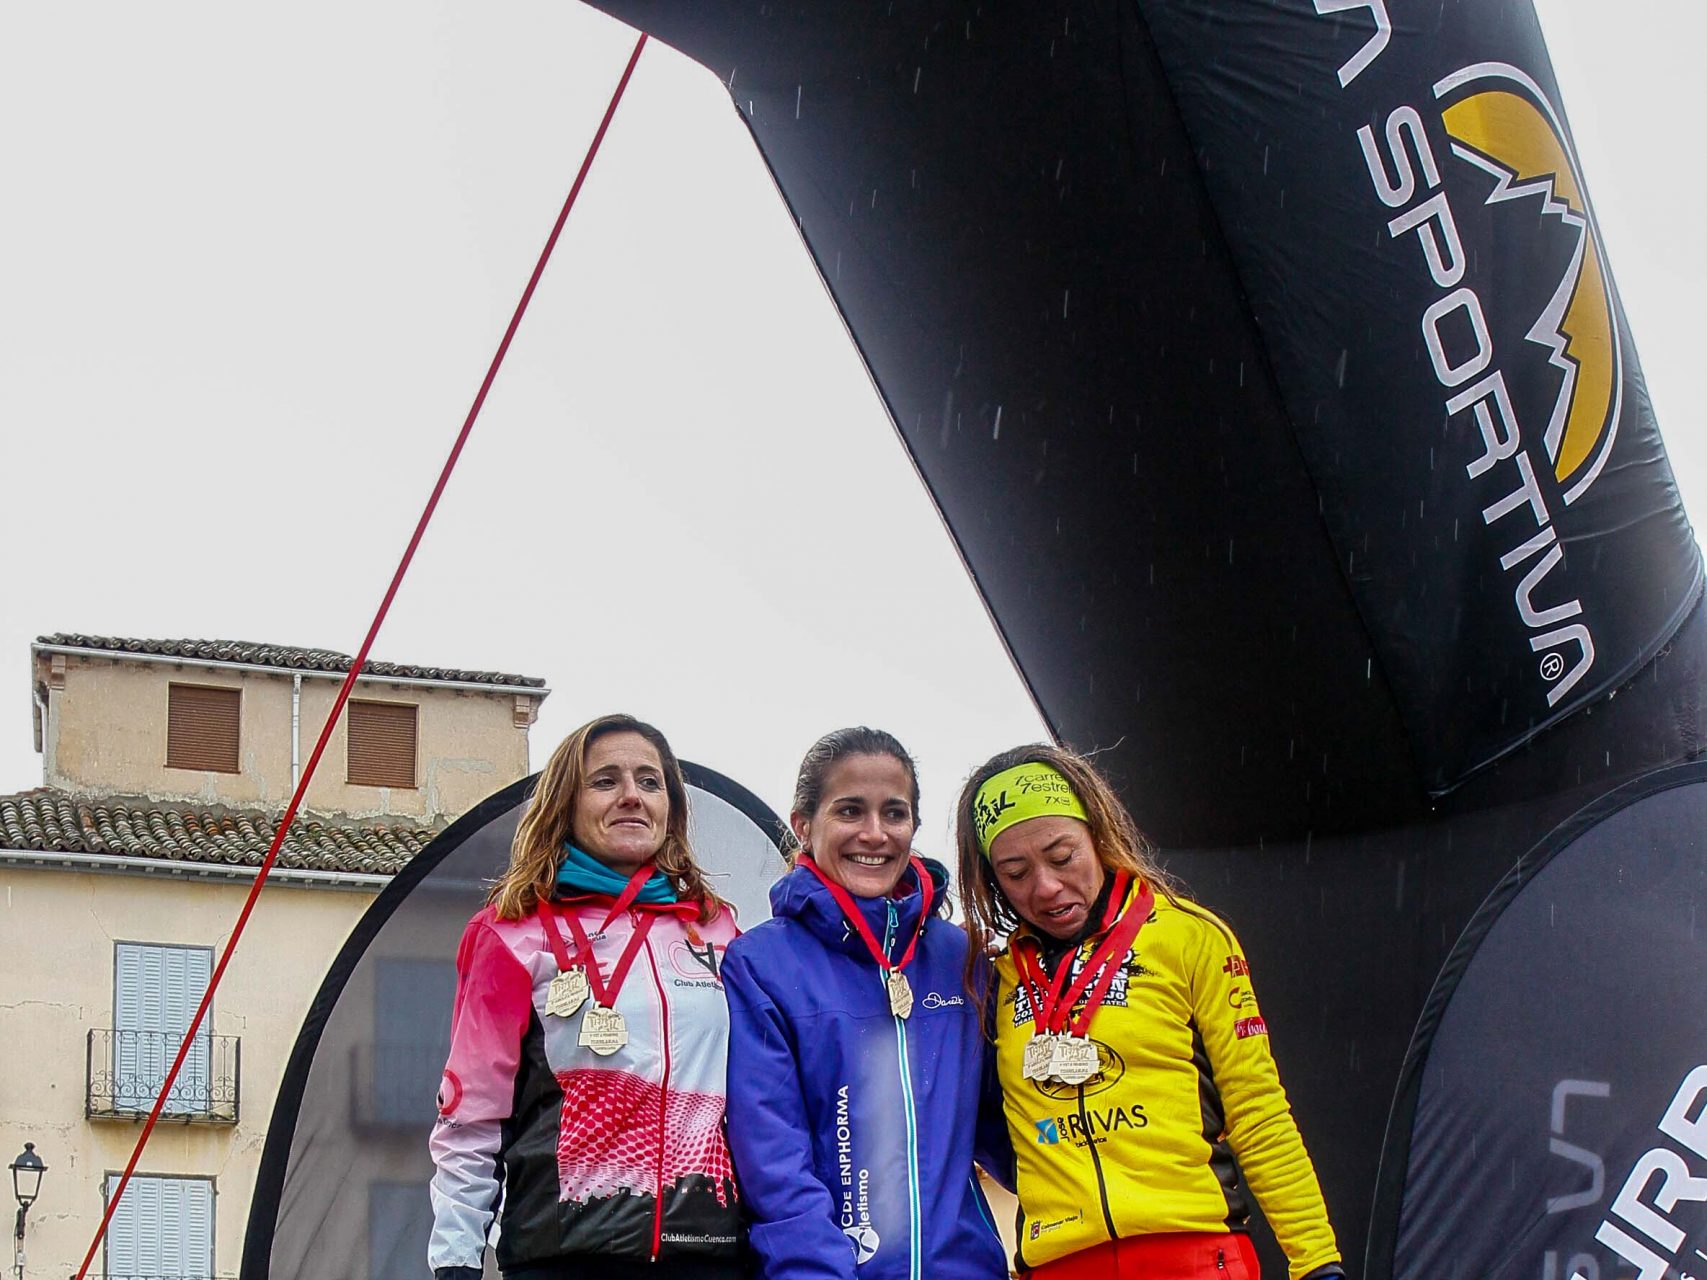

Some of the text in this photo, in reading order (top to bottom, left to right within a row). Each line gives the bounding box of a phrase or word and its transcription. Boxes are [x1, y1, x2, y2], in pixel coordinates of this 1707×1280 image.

[674, 979, 694, 988] Club
[1068, 1104, 1148, 1138] RIVAS
[836, 1085, 853, 1228] CDE ENPHORMA
